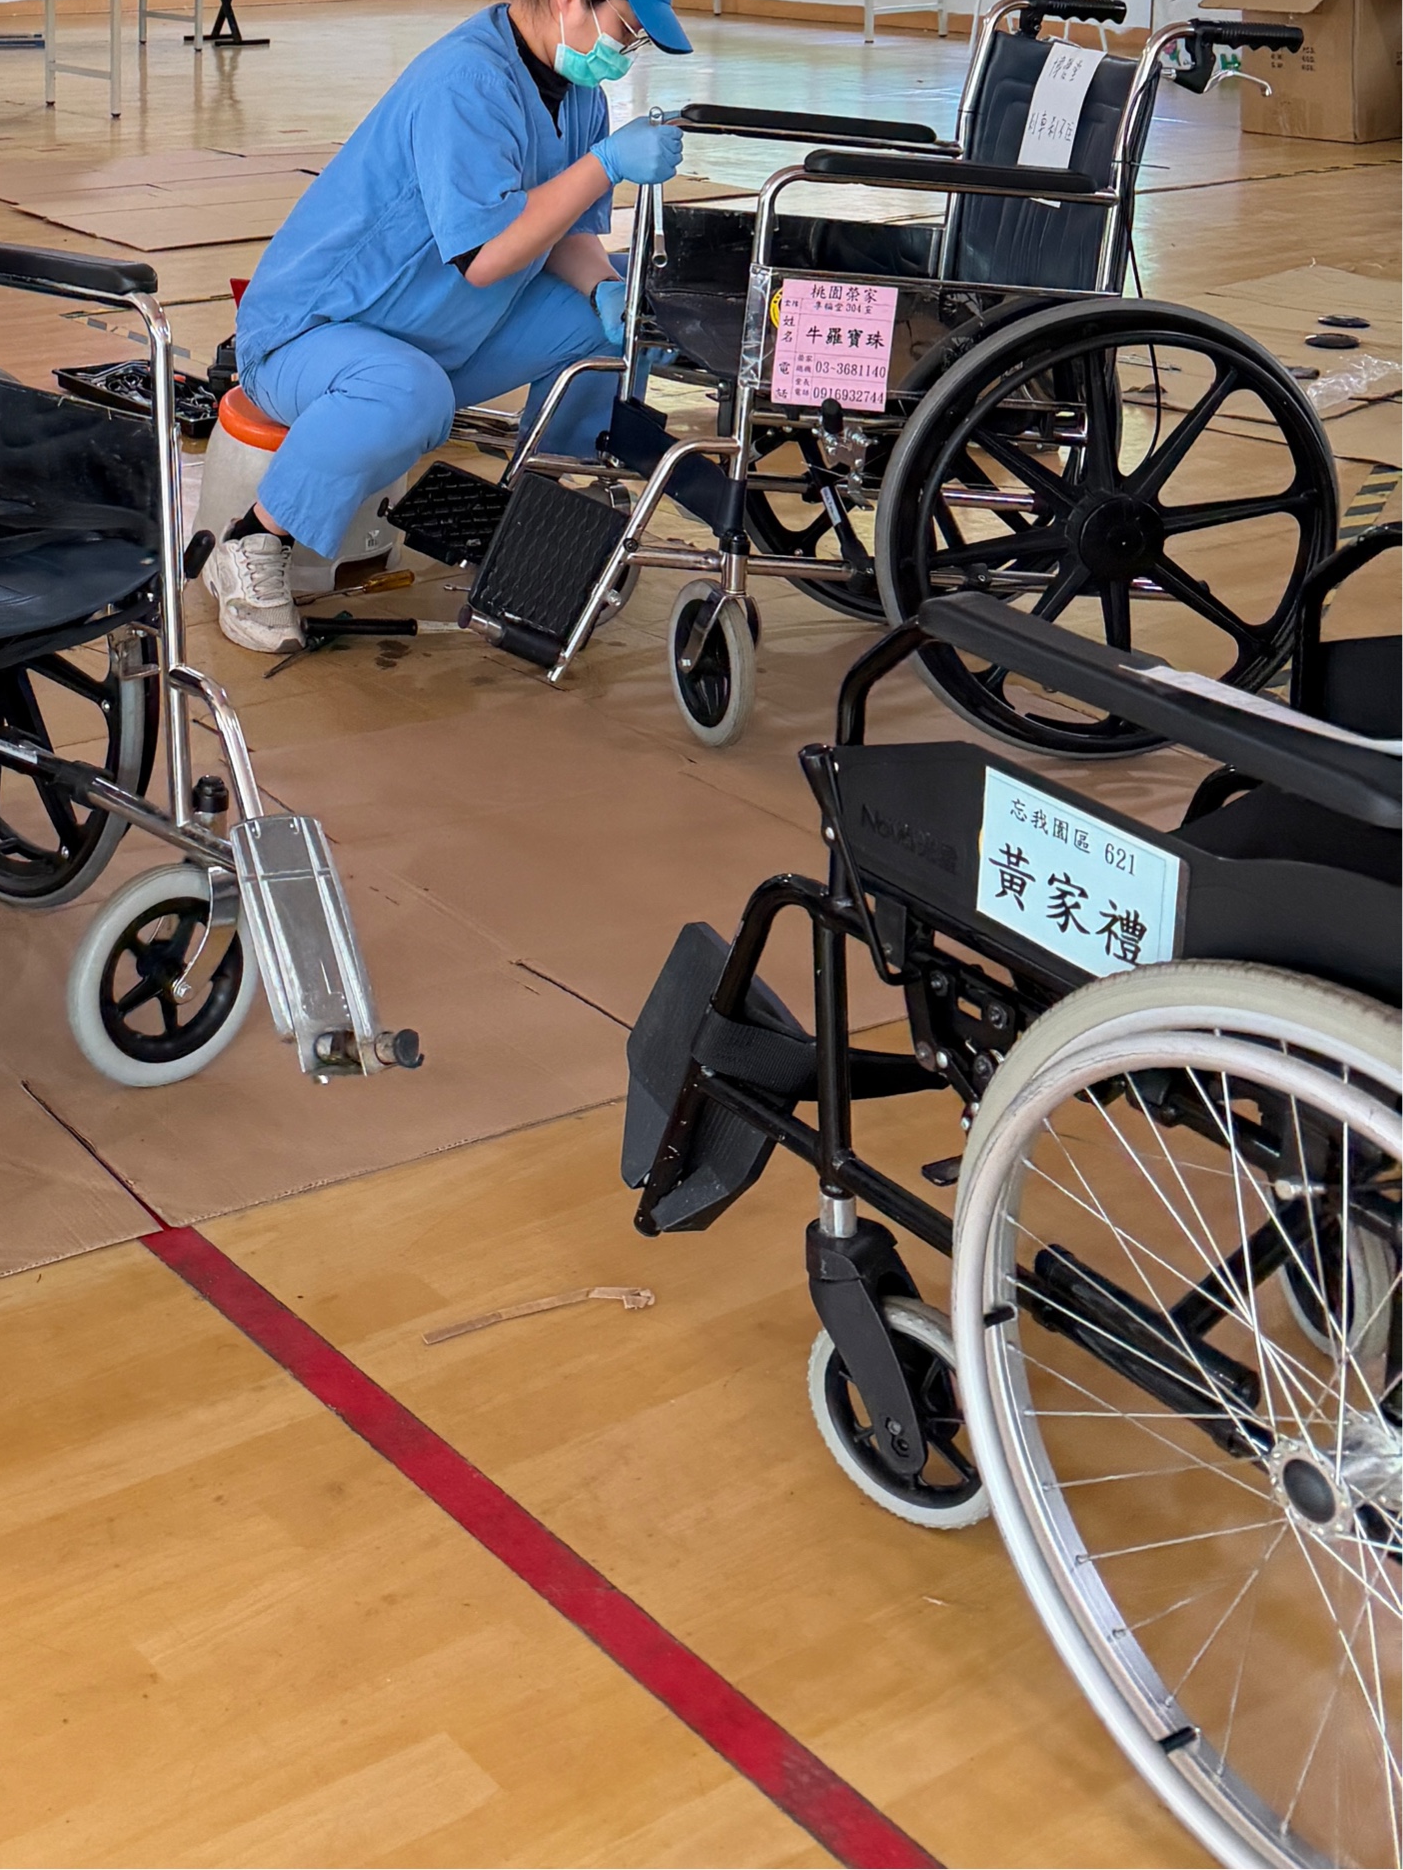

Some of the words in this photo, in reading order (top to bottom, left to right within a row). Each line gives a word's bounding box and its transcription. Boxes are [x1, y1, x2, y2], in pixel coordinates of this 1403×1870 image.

[810, 284, 878, 303] 桃園榮家
[781, 316, 795, 342] 姓名
[806, 326, 885, 349] 牛羅寶珠
[813, 387, 884, 405] 0916932744
[1010, 799, 1091, 854] 忘我園區
[1105, 843, 1135, 876] 621
[988, 843, 1147, 965] 黃家禮
